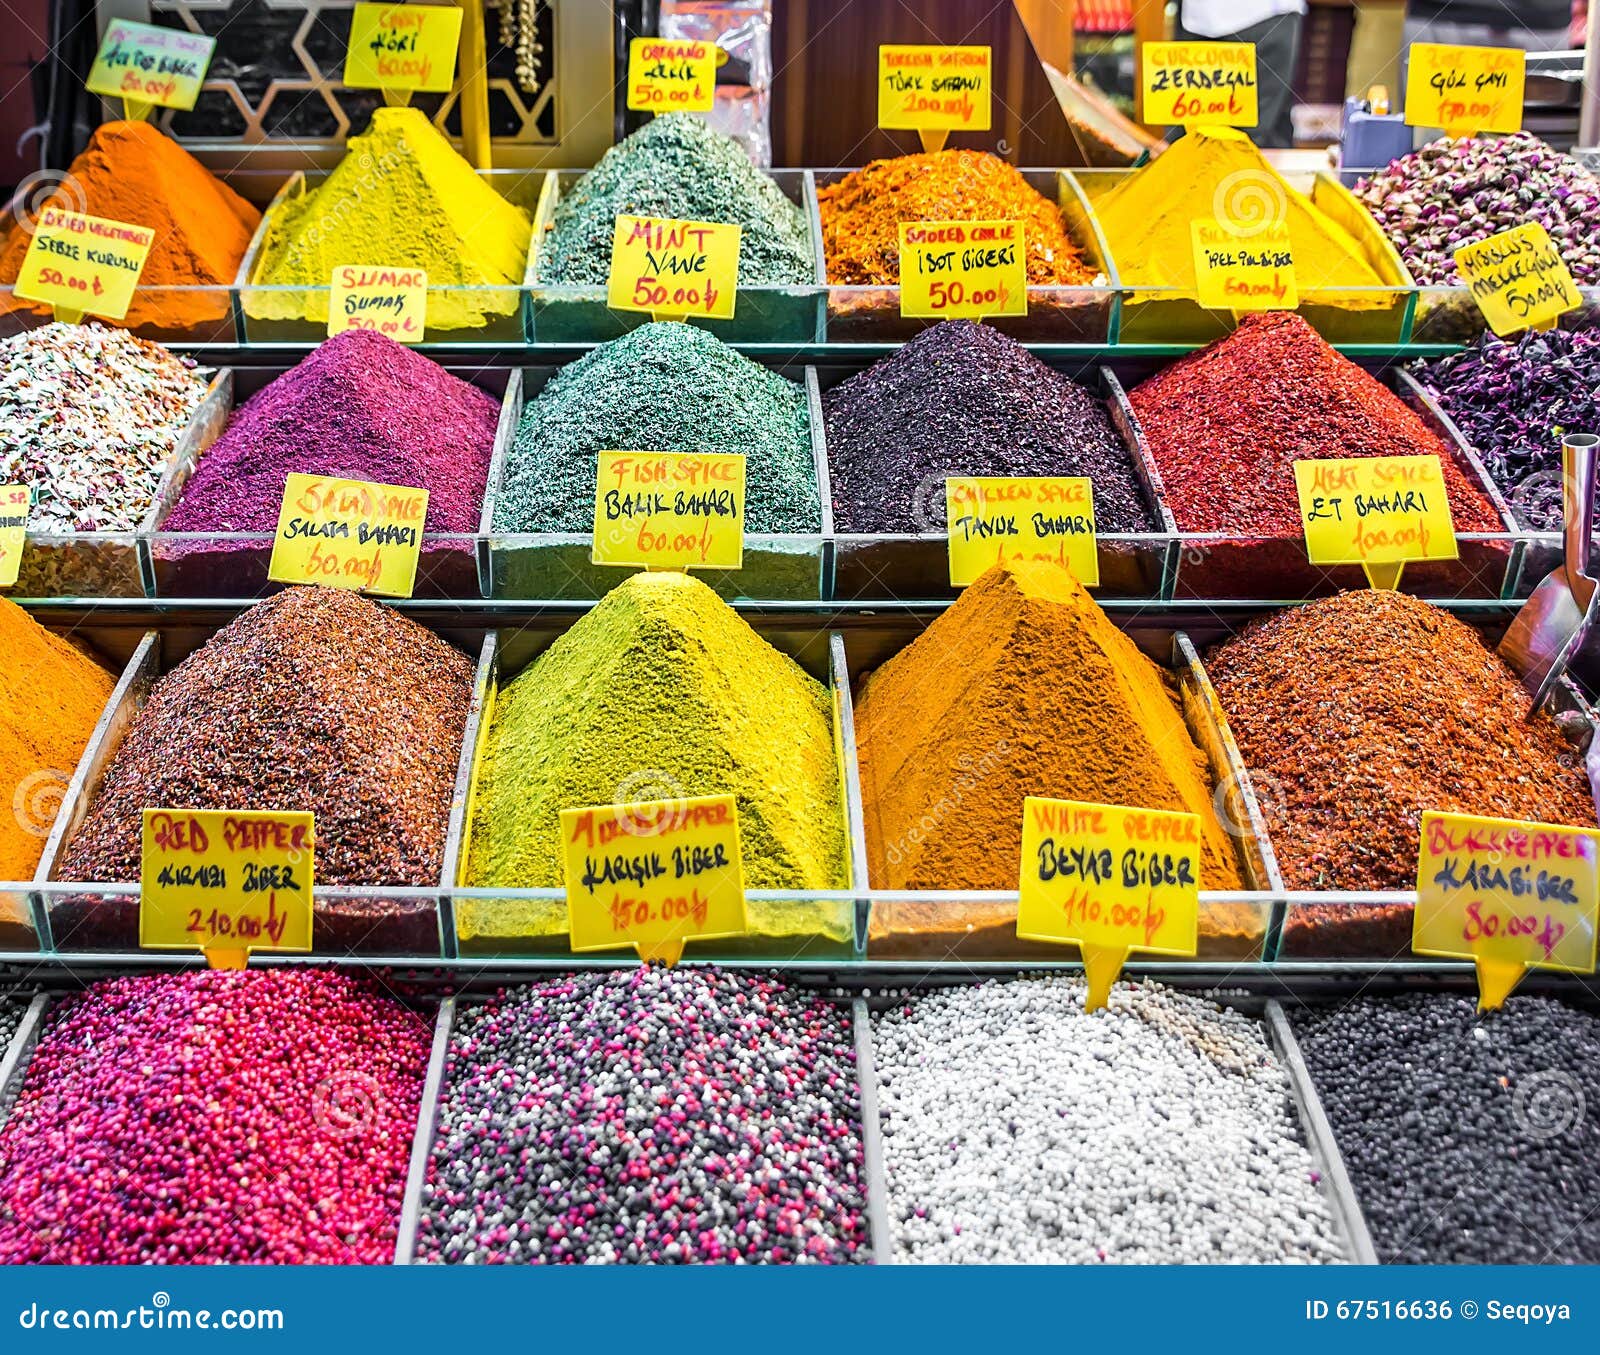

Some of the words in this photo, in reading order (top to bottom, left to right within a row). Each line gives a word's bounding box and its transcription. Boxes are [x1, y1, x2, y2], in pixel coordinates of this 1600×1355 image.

[44, 211, 86, 233] DRIED
[626, 220, 715, 253] MINT
[906, 227, 966, 244] SMOKED
[87, 249, 139, 272] KURUSU
[643, 250, 708, 276] NANE
[342, 268, 422, 288] SUMAC
[345, 294, 407, 316] SUMAK
[610, 458, 667, 488] FISH
[672, 458, 737, 485] SPICE
[1310, 465, 1359, 494] MEAT
[1371, 463, 1435, 488] SPICE
[296, 483, 373, 516] SALAD
[604, 489, 670, 520] BALIK
[674, 488, 737, 518] BAHARI
[953, 483, 1033, 503] CHICKEN
[1037, 482, 1085, 503] SPICE
[1308, 497, 1342, 521] ET
[1354, 491, 1428, 517] BAHARI
[284, 518, 349, 539] SALATA
[358, 522, 416, 547] BAHARI
[956, 515, 1019, 542] TAVUK
[1031, 512, 1093, 538] BAHARI
[150, 812, 209, 855] RED
[223, 817, 313, 851] PEPPER
[656, 803, 734, 836] PEPPER
[1033, 805, 1108, 835] WHITE
[1123, 814, 1198, 843] PEPPER
[582, 852, 666, 895] KARIŞIK
[1038, 838, 1112, 885] BEYAZ
[1122, 847, 1195, 888] BİBER
